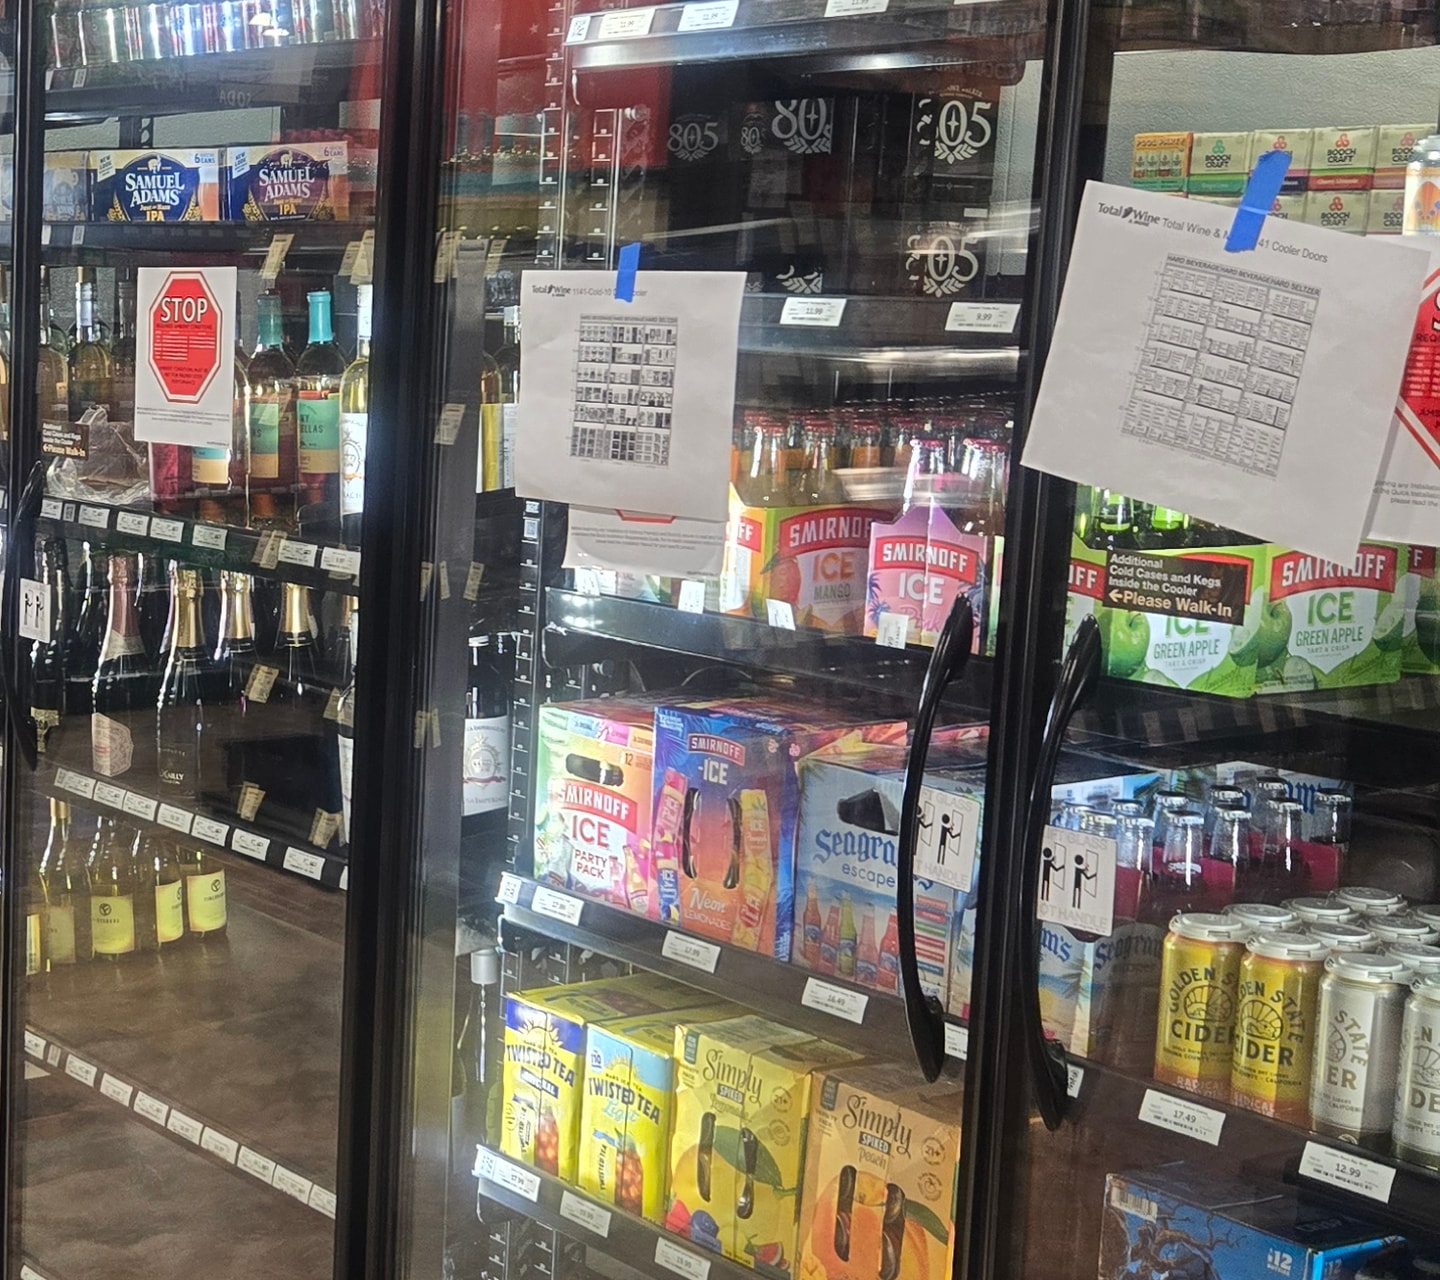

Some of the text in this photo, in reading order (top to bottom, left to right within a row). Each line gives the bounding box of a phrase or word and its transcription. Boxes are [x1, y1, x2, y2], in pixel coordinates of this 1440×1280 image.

[1205, 154, 1231, 162] BOOCH
[1327, 148, 1356, 157] BOOCH
[1328, 154, 1355, 163] CRAFT
[1205, 160, 1229, 169] CRAFT
[125, 172, 185, 191] SAMUEL
[259, 167, 315, 186] SAMUEL
[130, 188, 180, 207] ADAMS
[264, 183, 311, 202] ADAMS
[279, 204, 297, 216] IPA
[1321, 212, 1350, 221] BOOCH
[1098, 202, 1328, 263] Total Wine Total Wine & Cooler Doors
[1321, 219, 1347, 227] CRAFT
[1167, 254, 1220, 271] HARD BEVERAGE
[1221, 266, 1271, 284] HARD BEVERAGE
[532, 284, 547, 294] Total
[554, 286, 571, 295] Wine
[1271, 278, 1321, 296] HARD SELTZER
[160, 296, 209, 324] STOP
[805, 307, 824, 316] 11.99
[789, 516, 872, 547] SMIRNOF
[813, 551, 856, 581] ICE
[882, 543, 968, 572] SMIRNOFF
[1109, 553, 1163, 569] Additional
[1109, 564, 1222, 588] Cold Cases and Kegs
[813, 583, 852, 600] MANGO
[898, 573, 944, 605] ICE
[1108, 575, 1198, 598] Inside the Cooler
[1123, 590, 1233, 618] Please Walk-In
[1307, 591, 1356, 625] ICE
[1295, 626, 1364, 646] GREEN APPLE
[1153, 639, 1220, 659] GREEN APPLE
[690, 736, 742, 760] SMIRNOFF
[624, 752, 634, 766] 12
[703, 759, 729, 785] ICE
[558, 784, 630, 821] SMIRNOFF
[934, 793, 973, 813] GLASS
[572, 815, 610, 849] ICE
[813, 827, 898, 867] Seagra
[574, 849, 609, 868] PARTY
[576, 862, 605, 880] PACK
[841, 862, 896, 888] escape
[924, 864, 969, 888] HANDLE
[690, 887, 727, 913] Neon
[1169, 967, 1216, 1014] GOLDEN
[1270, 990, 1305, 1044] STATE
[1335, 1010, 1368, 1068] STATE
[506, 1044, 575, 1088] TWISTED TEA
[702, 1048, 764, 1106] Simply
[588, 1077, 661, 1125] TWISTED TEA
[718, 1084, 744, 1104] SPIKED
[603, 1099, 640, 1123] Light
[1173, 1109, 1197, 1124] 17.49
[842, 1094, 912, 1158] Simply
[860, 1134, 890, 1153] SPIKED
[1335, 1162, 1361, 1178] 12.99
[1272, 1250, 1293, 1272] 12
